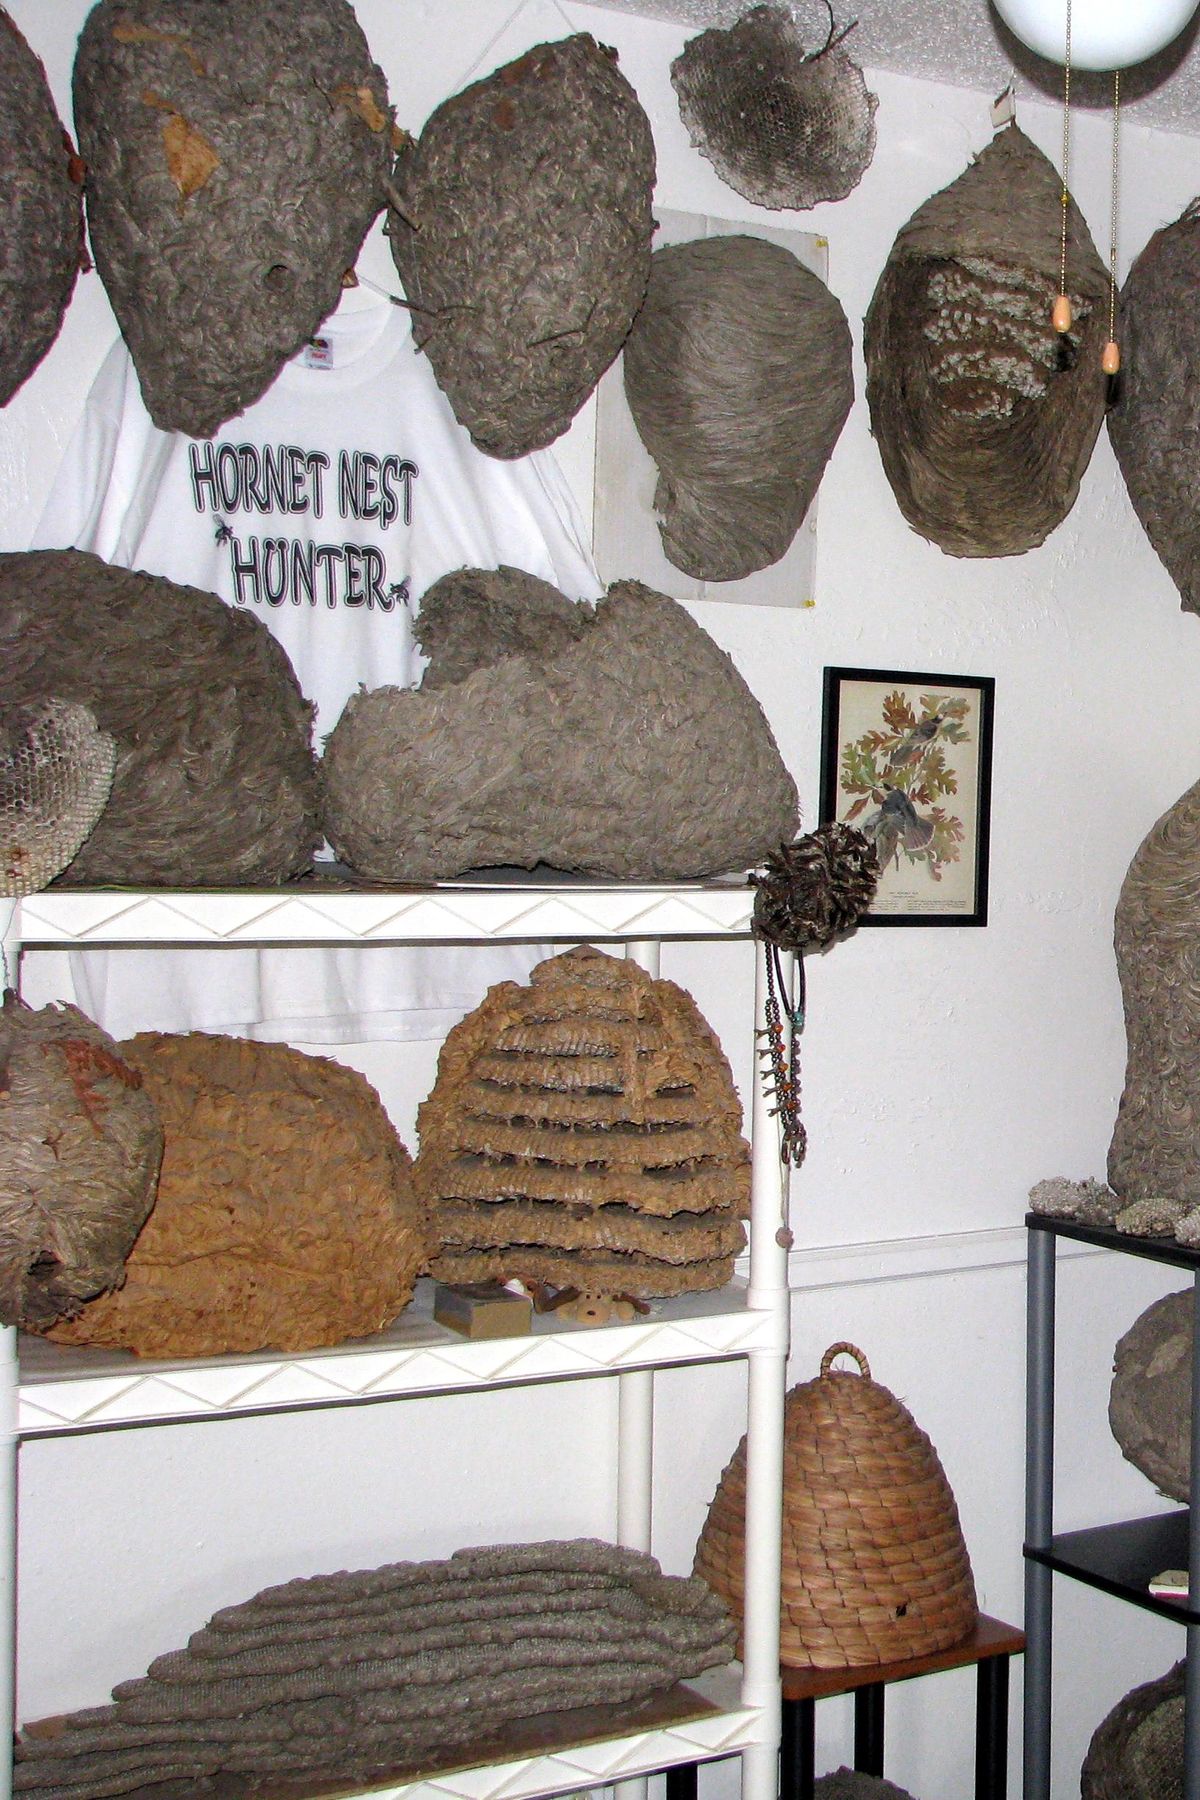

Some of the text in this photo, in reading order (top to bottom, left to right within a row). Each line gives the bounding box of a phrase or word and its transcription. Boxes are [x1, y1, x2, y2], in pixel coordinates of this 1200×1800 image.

[189, 442, 419, 529] HORNET NEST
[232, 536, 394, 612] HUNTER
